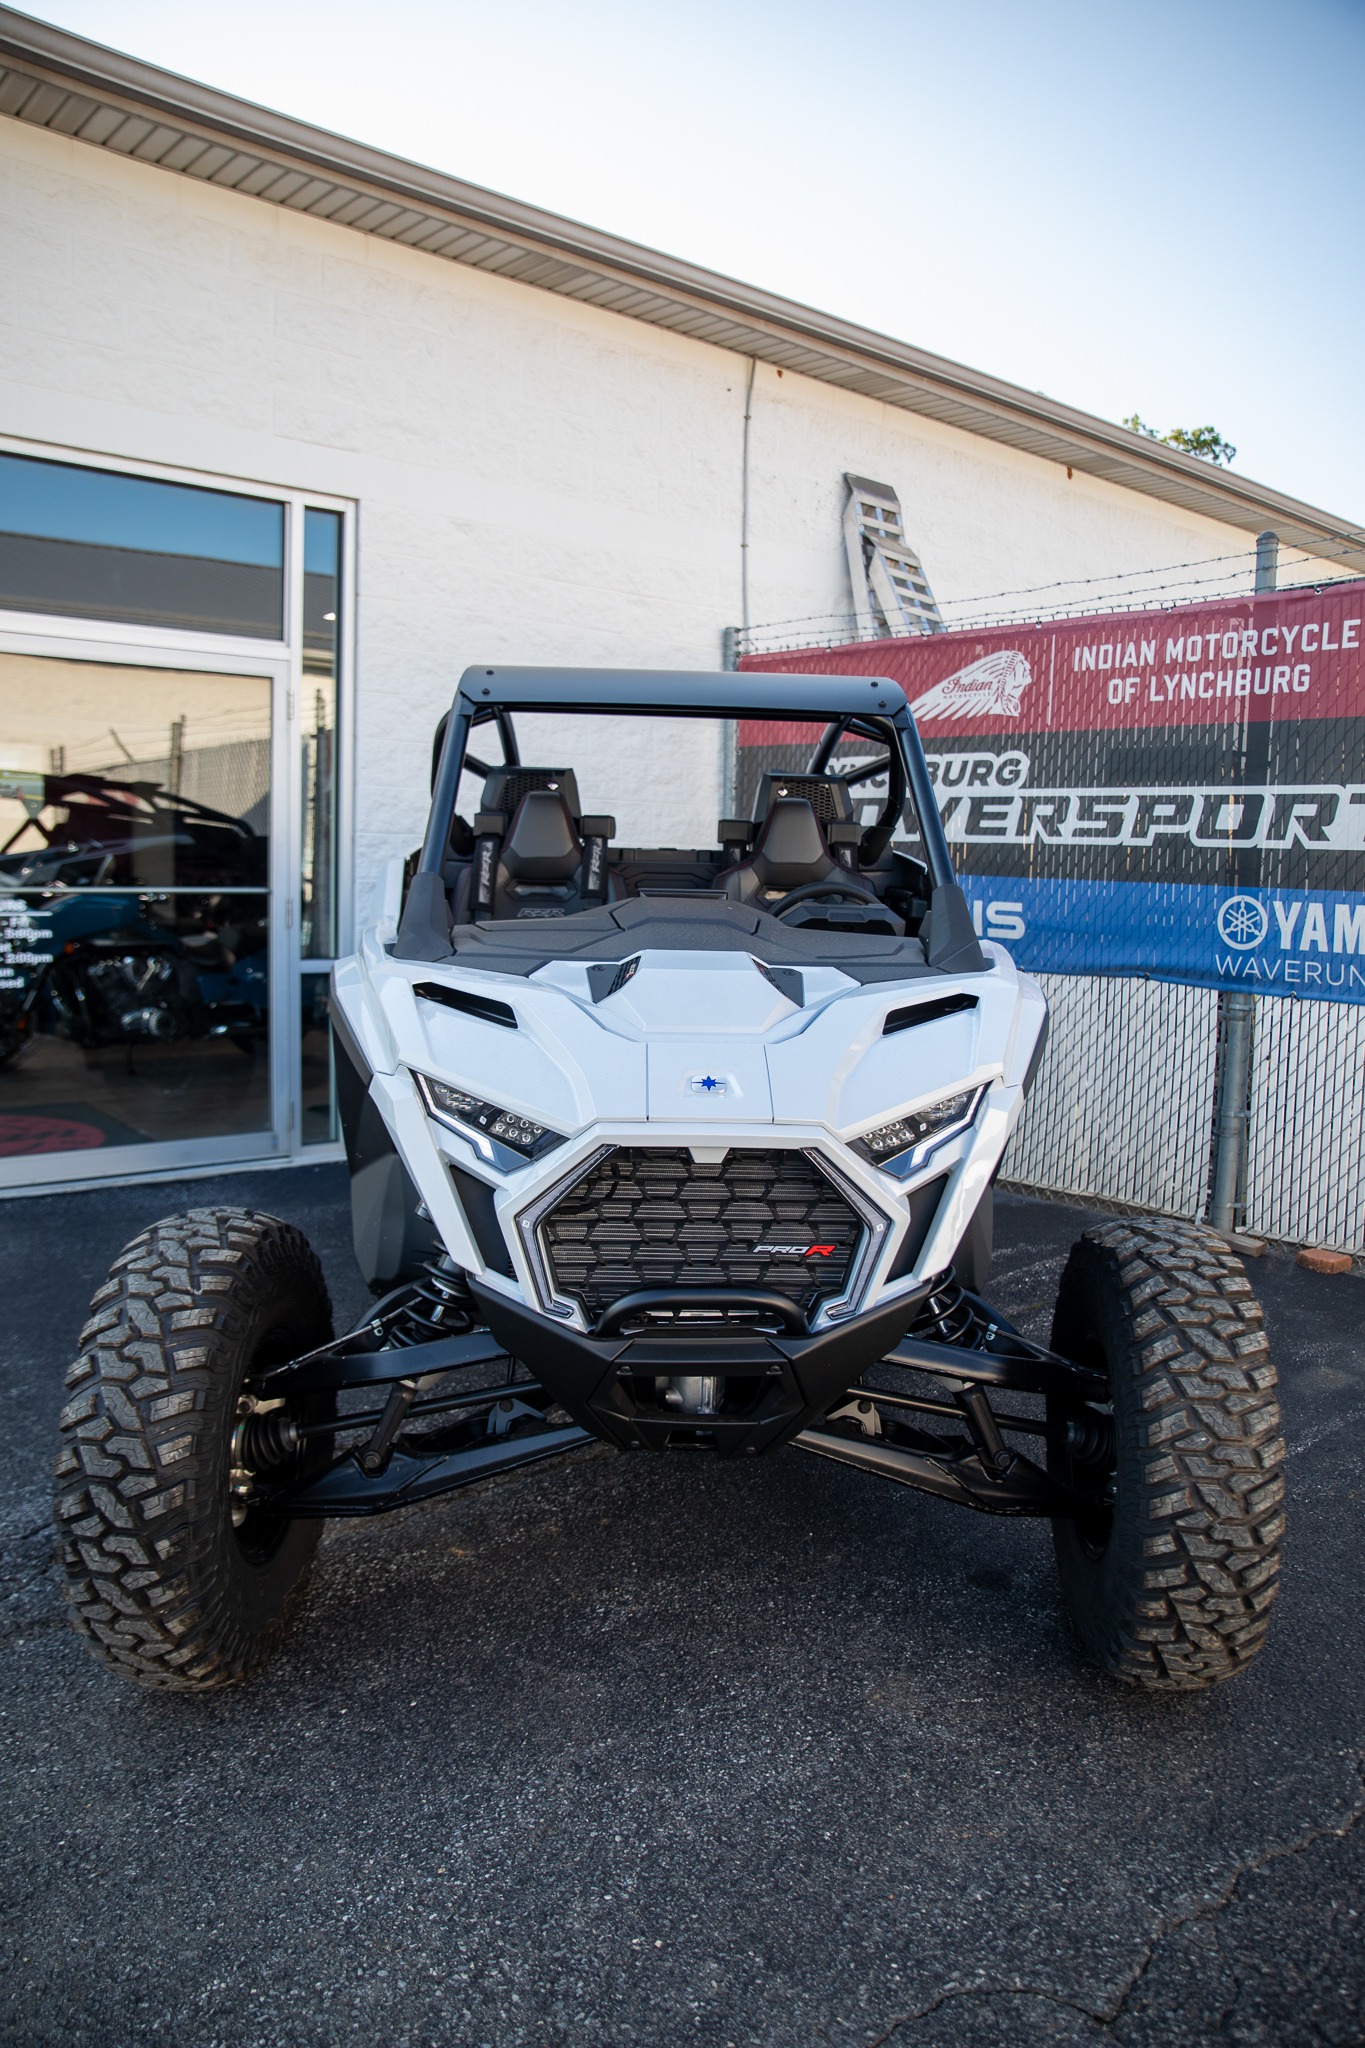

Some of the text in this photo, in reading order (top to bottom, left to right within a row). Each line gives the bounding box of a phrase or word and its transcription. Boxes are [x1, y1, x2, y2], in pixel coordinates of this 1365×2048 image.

[1073, 619, 1361, 672] INDIAN MOTORCYCLE
[942, 676, 993, 694] Indian
[1107, 663, 1311, 705] OF LYNCHBURG
[516, 908, 566, 918] RZR
